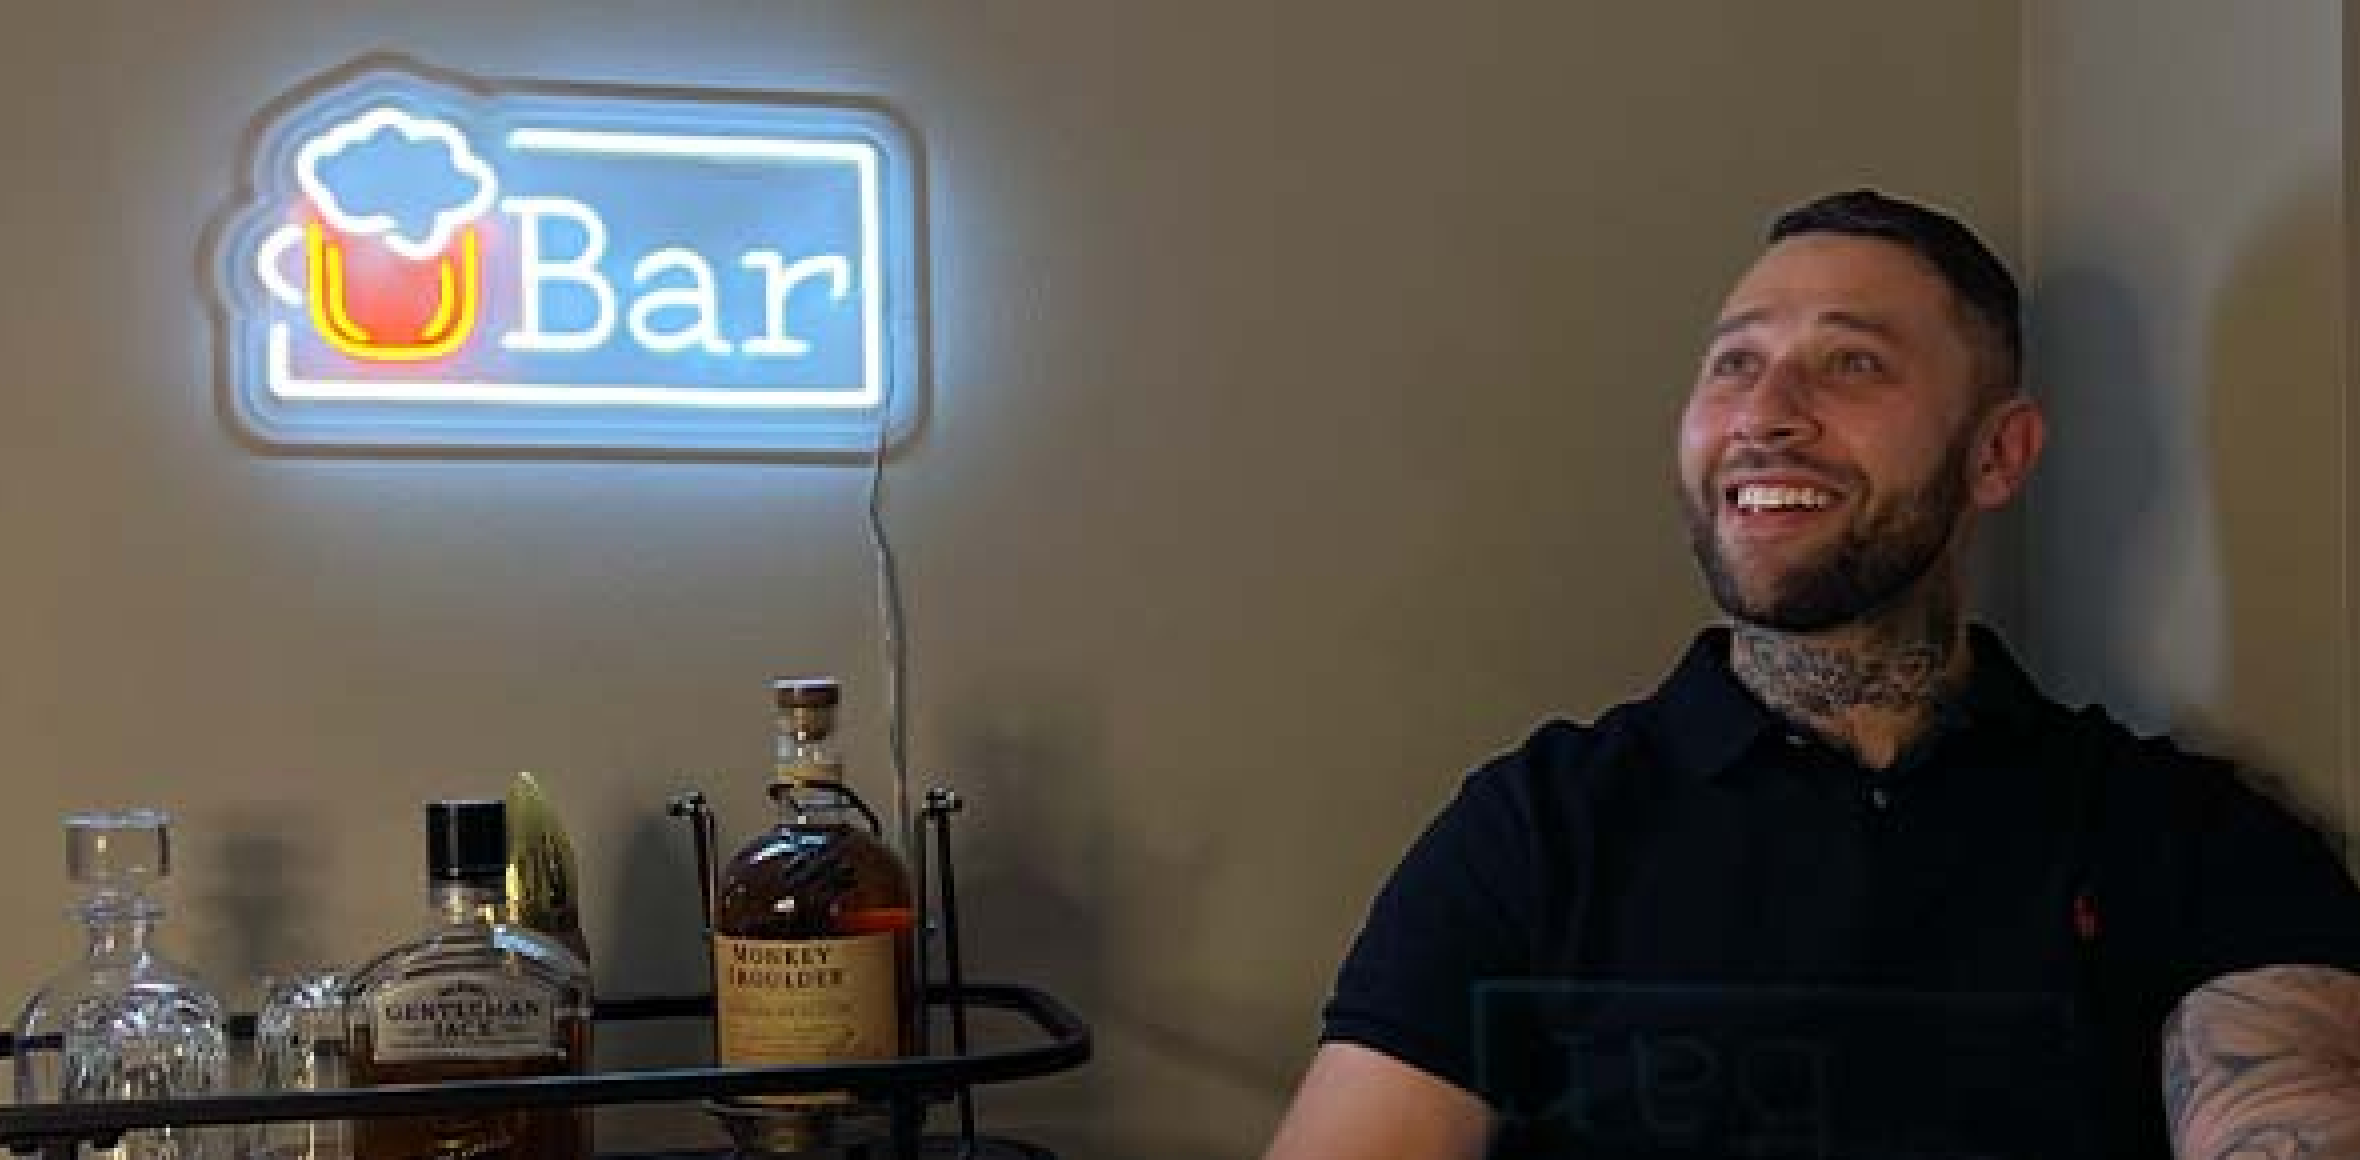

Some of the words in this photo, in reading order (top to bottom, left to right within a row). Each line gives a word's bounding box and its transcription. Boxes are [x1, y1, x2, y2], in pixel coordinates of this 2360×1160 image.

[500, 196, 852, 357] Bar
[732, 943, 831, 965] MONKEY
[385, 999, 539, 1021] GENTLEMAN
